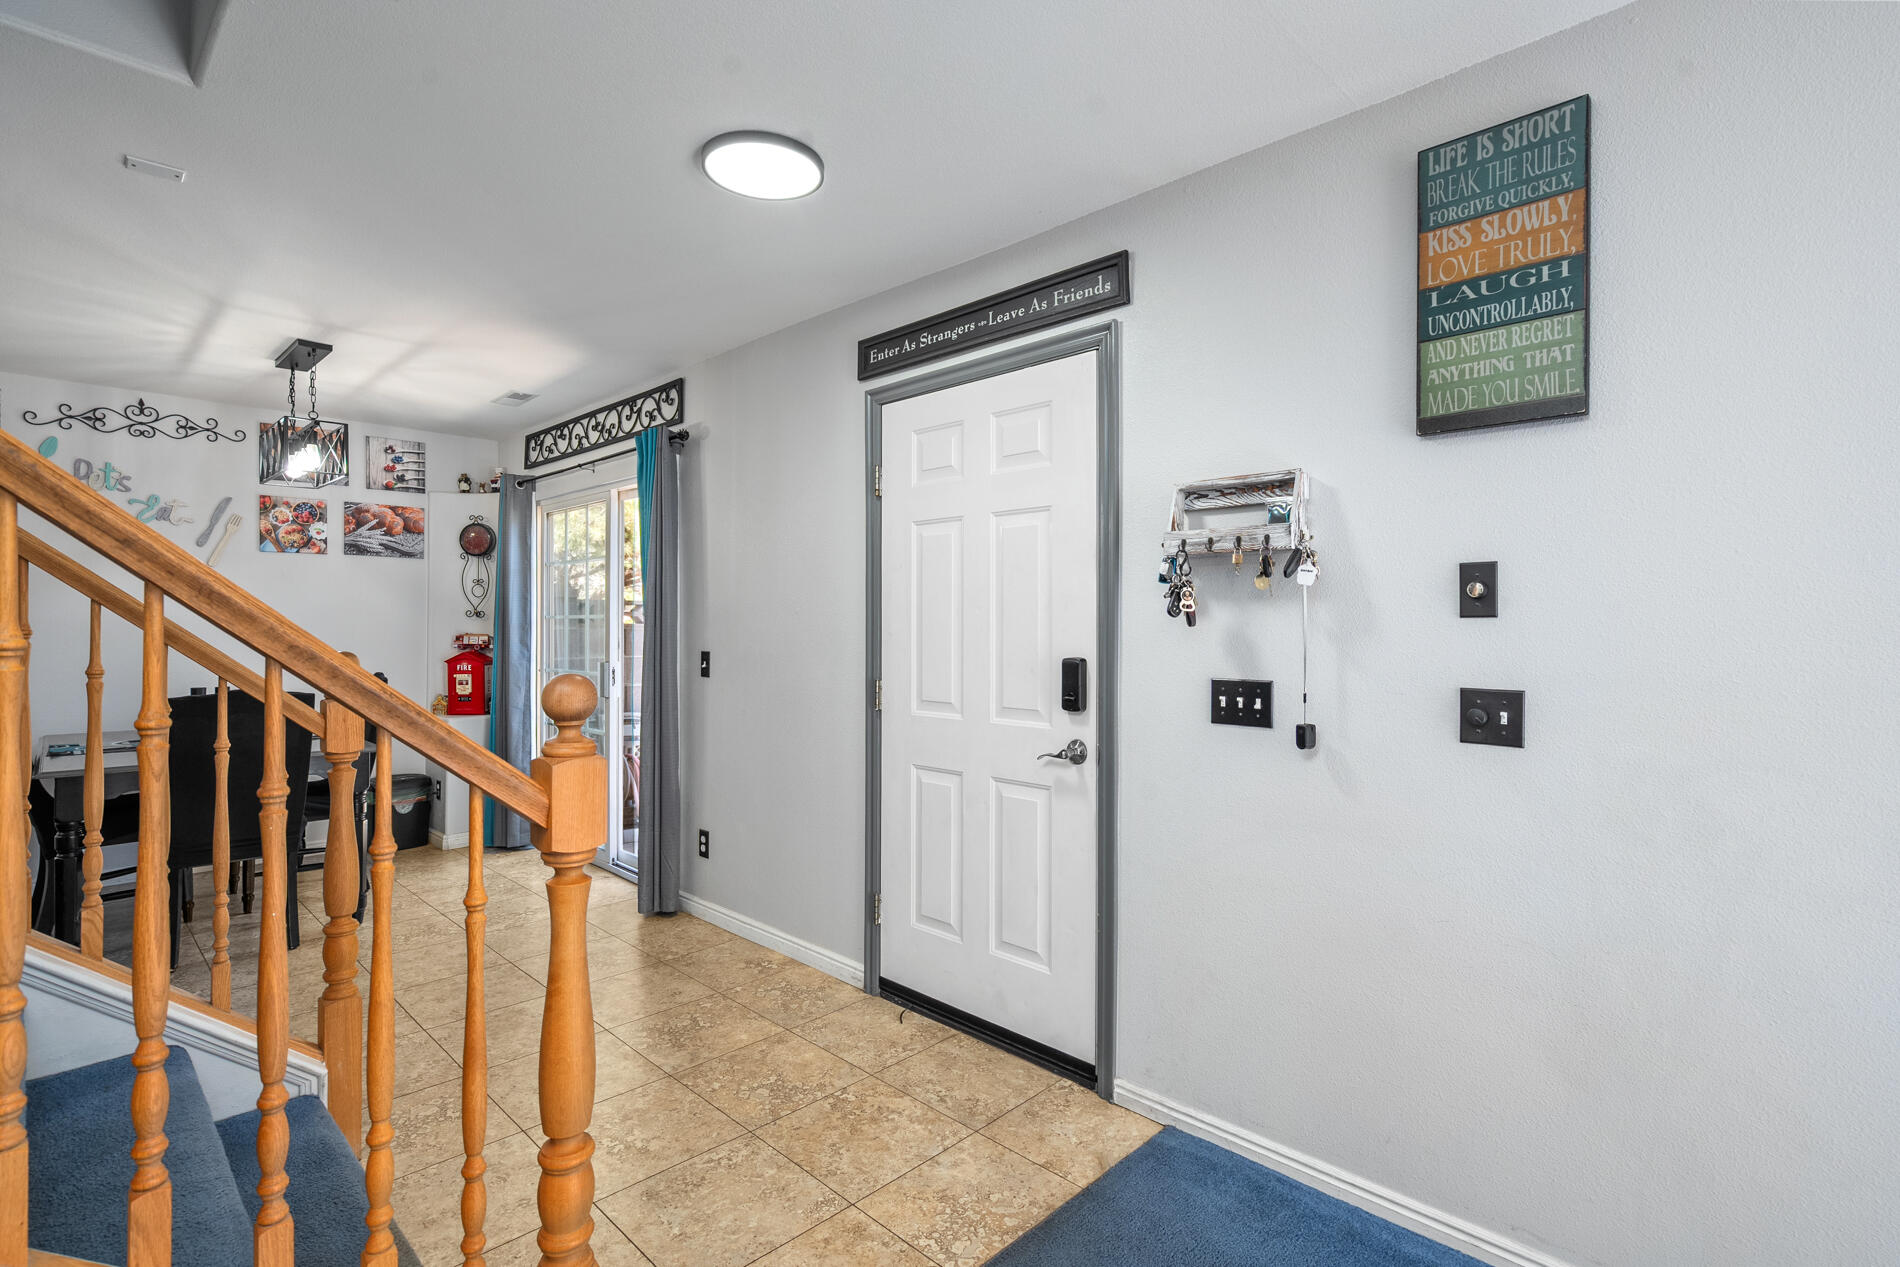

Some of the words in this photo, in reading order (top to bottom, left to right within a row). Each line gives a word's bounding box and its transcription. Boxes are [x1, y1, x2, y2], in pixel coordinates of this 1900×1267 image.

[1428, 141, 1468, 176] LIFE
[1476, 132, 1494, 161] IS
[1502, 104, 1575, 151] SHORT
[1427, 166, 1481, 208] BREAK
[1485, 155, 1518, 190] THE
[1522, 136, 1577, 179] RULES
[1428, 195, 1495, 227] FORGIVE
[1498, 171, 1575, 208] QUICKLY,
[1427, 249, 1488, 286] LOVE
[1494, 225, 1577, 268] TRULY,
[1428, 223, 1472, 257] KISS
[1427, 259, 1573, 308] LAUGH
[869, 345, 900, 364] Enter
[901, 337, 917, 354] As
[918, 320, 976, 349] Strangers
[988, 307, 1025, 326] Leave
[1029, 297, 1048, 314] As
[1052, 275, 1112, 308] Friends
[1428, 286, 1575, 336] UNCONTROLLABLY,
[1427, 339, 1457, 364] AND
[1460, 329, 1508, 357] NEVER
[1511, 314, 1575, 348] REGRET
[1427, 355, 1515, 386] ANYTHING
[1522, 343, 1576, 369] THAT
[1427, 385, 1479, 416] MADE
[1482, 377, 1520, 406] YOU
[1524, 367, 1580, 400] SMILE.
